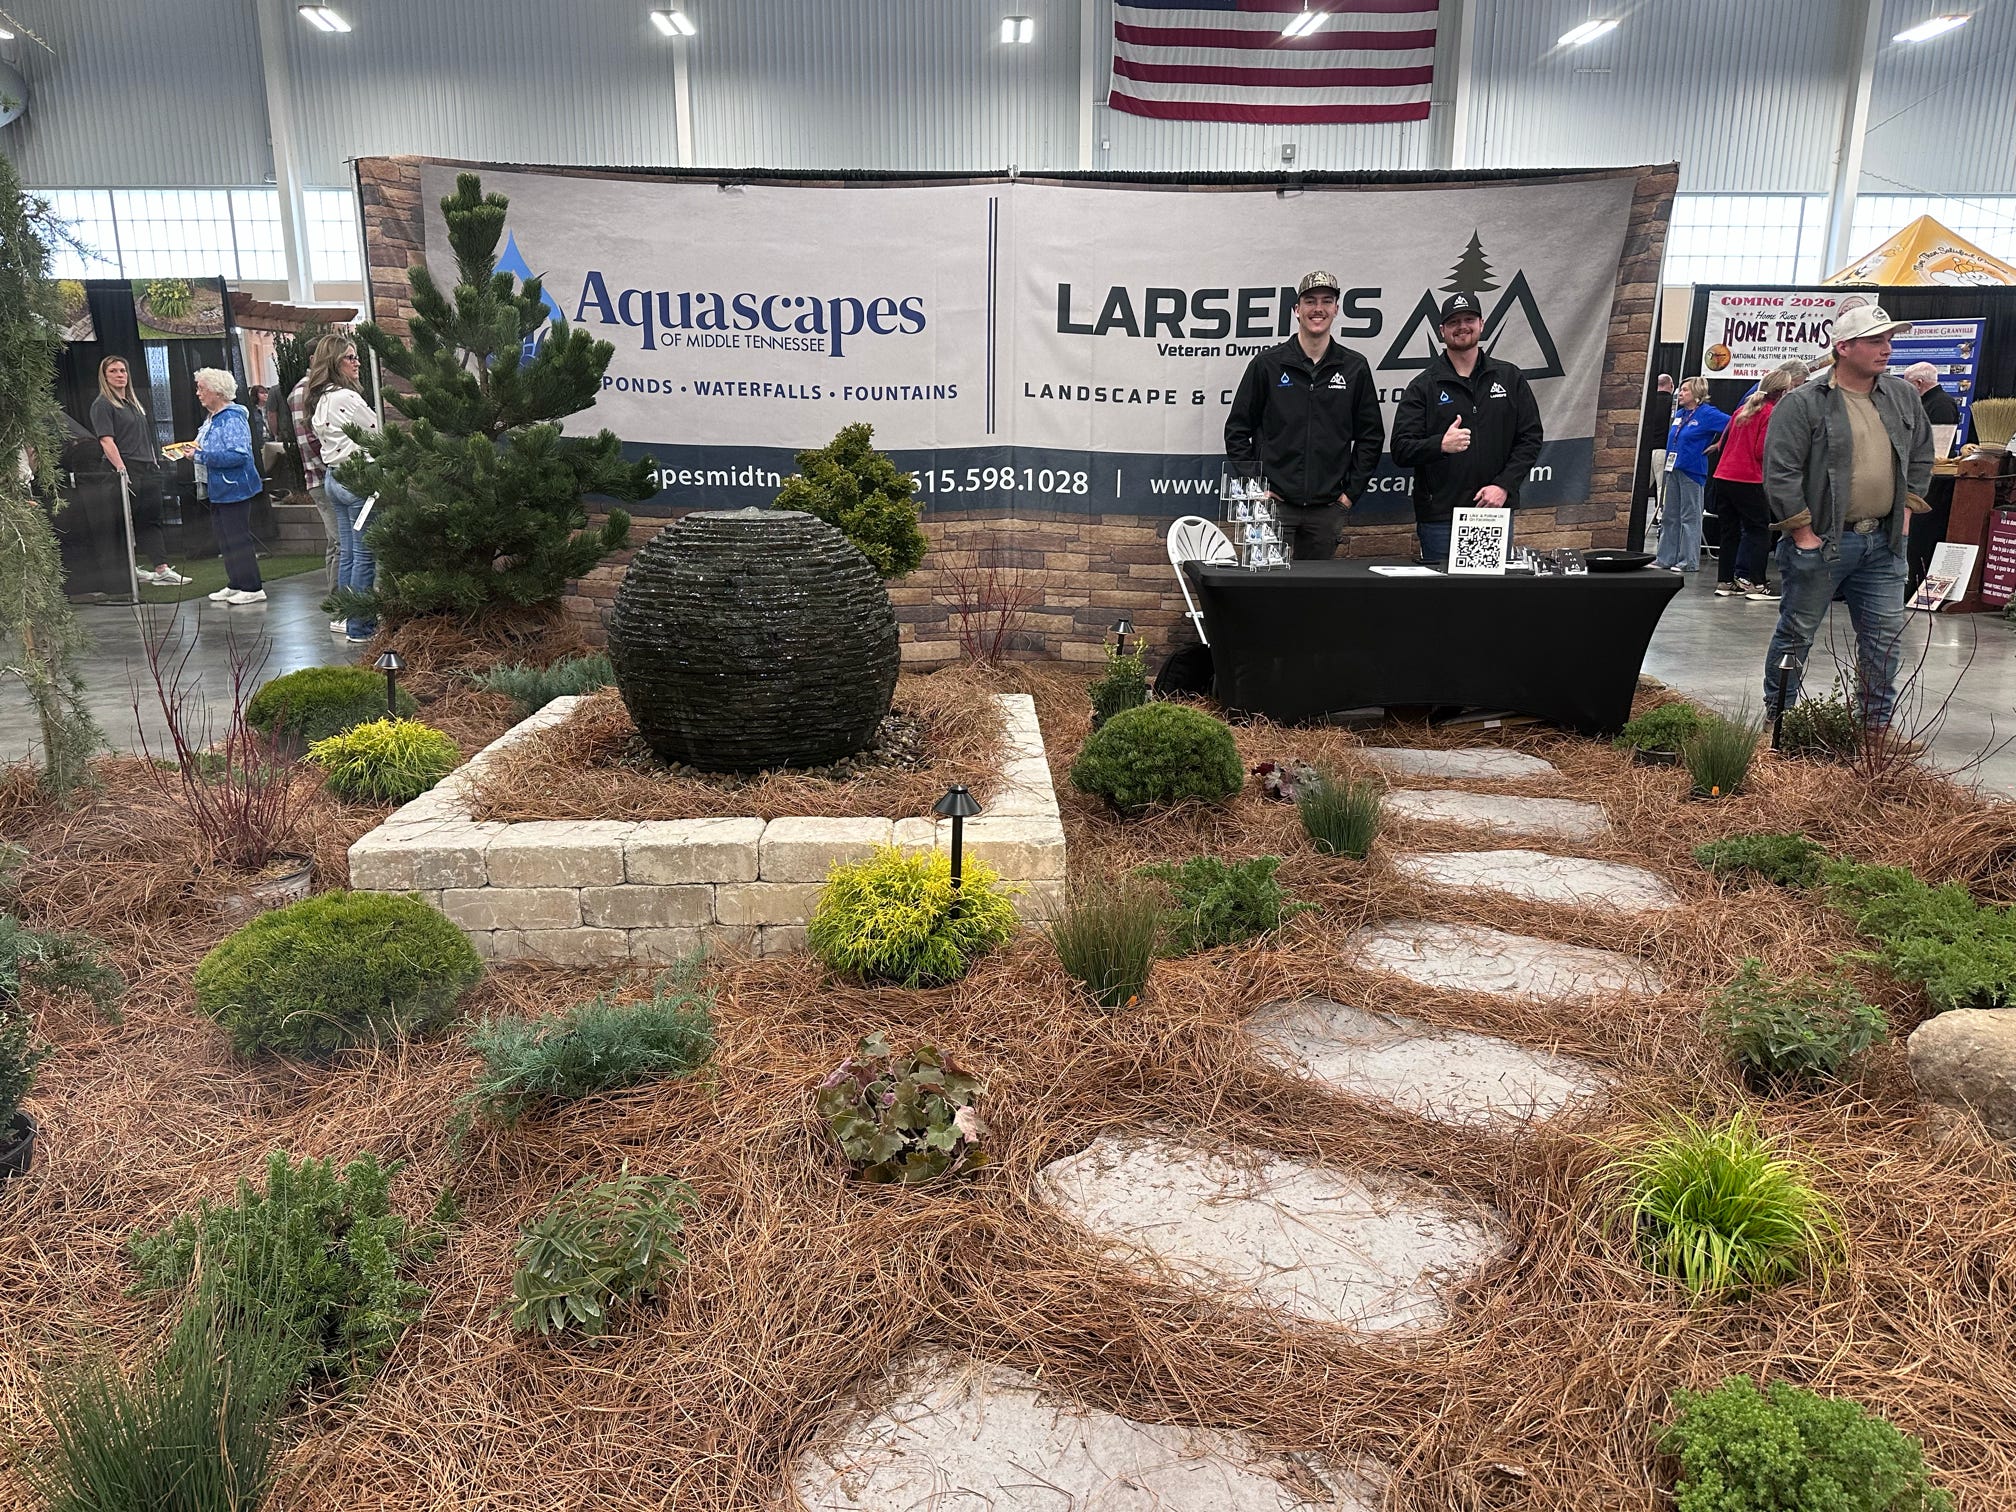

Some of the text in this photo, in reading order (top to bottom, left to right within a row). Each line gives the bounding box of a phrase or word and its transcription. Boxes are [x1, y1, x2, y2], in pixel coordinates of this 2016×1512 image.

[1721, 296, 1836, 308] COMING 2026
[573, 270, 927, 358] Aquascapes
[1755, 311, 1777, 320] Home
[1780, 311, 1798, 320] Runs
[660, 332, 826, 352] OF MIDDLE TENNESSEE
[1723, 317, 1834, 349] HOME TEAMS
[1157, 343, 1282, 358] Veteran Own
[1733, 369, 1749, 377] MAR
[602, 375, 958, 401] PONDS WATERFALLS FOUNTAINS
[1024, 382, 1177, 405] LANDSCAPE
[1191, 389, 1205, 405] &
[909, 466, 1089, 495] 615.598.1028
